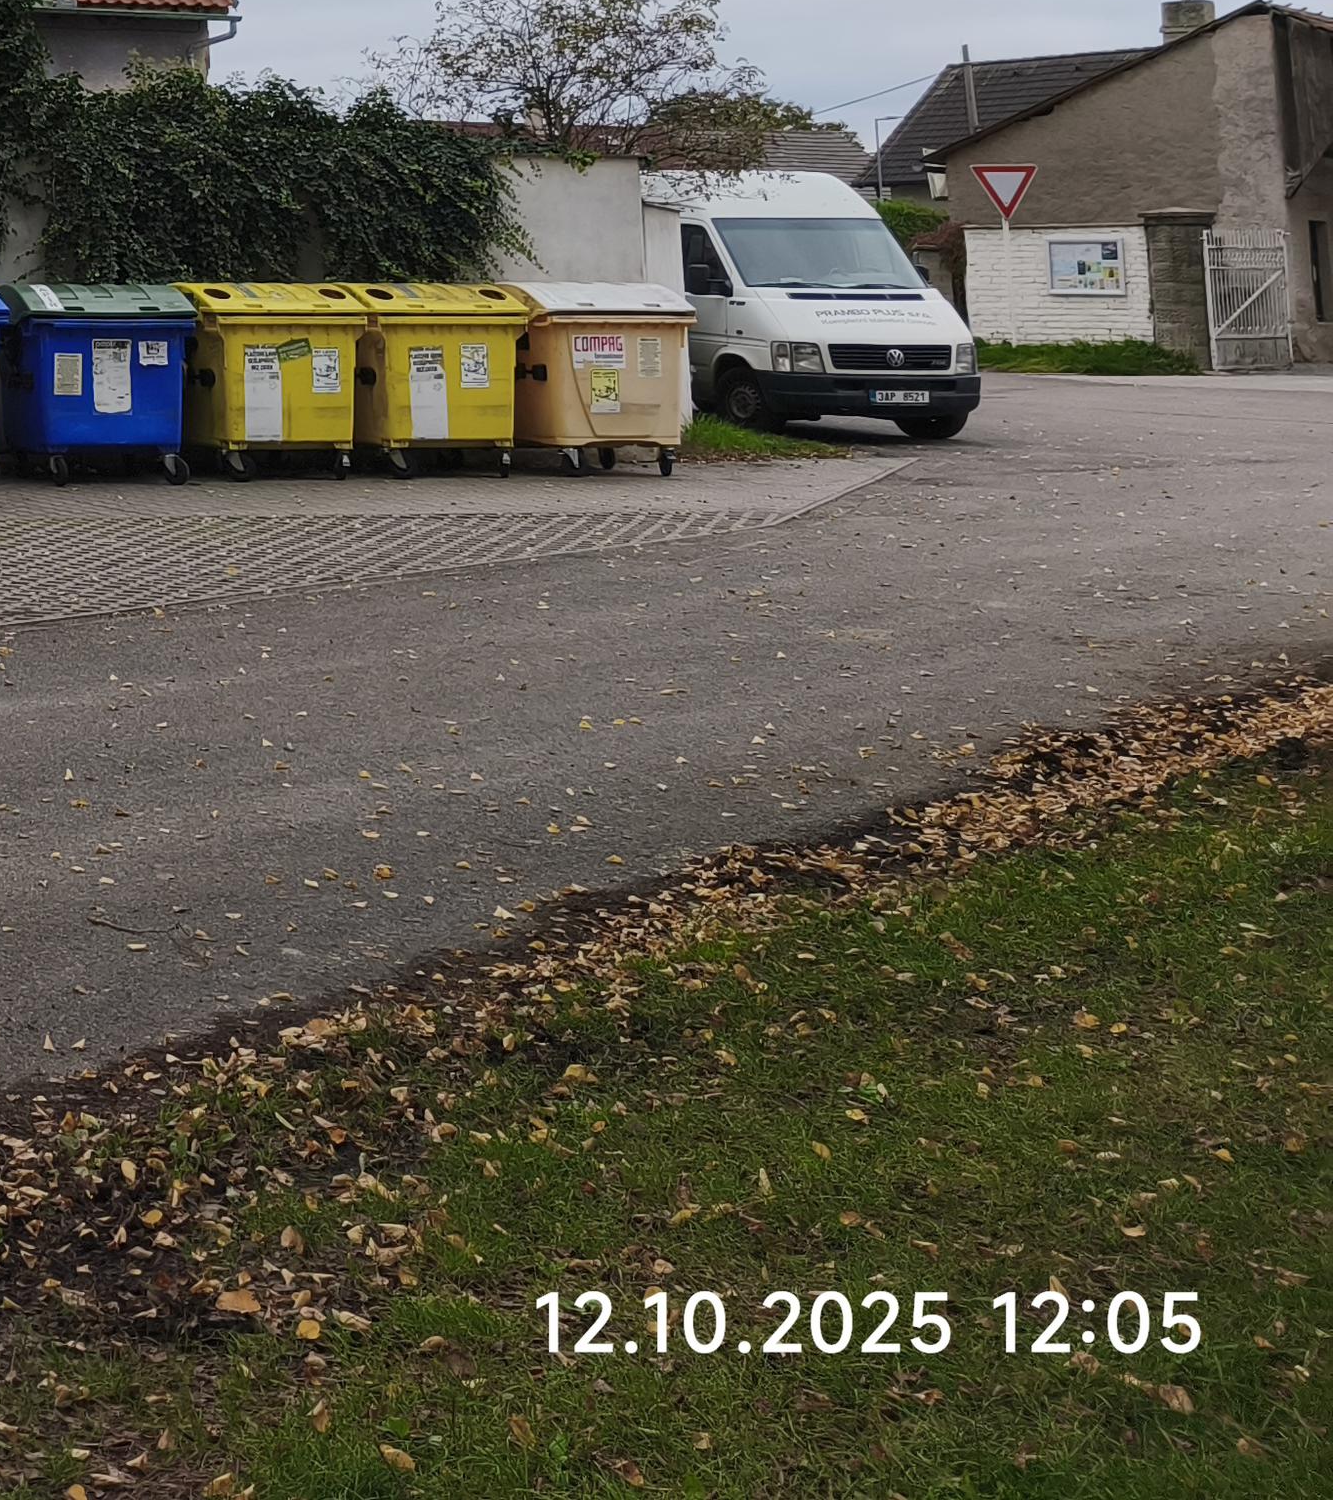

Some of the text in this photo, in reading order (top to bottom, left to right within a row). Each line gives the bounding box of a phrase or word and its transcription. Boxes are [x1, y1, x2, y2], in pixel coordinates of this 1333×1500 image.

[574, 336, 623, 352] COMPAG
[878, 392, 926, 401] 3AP 8521
